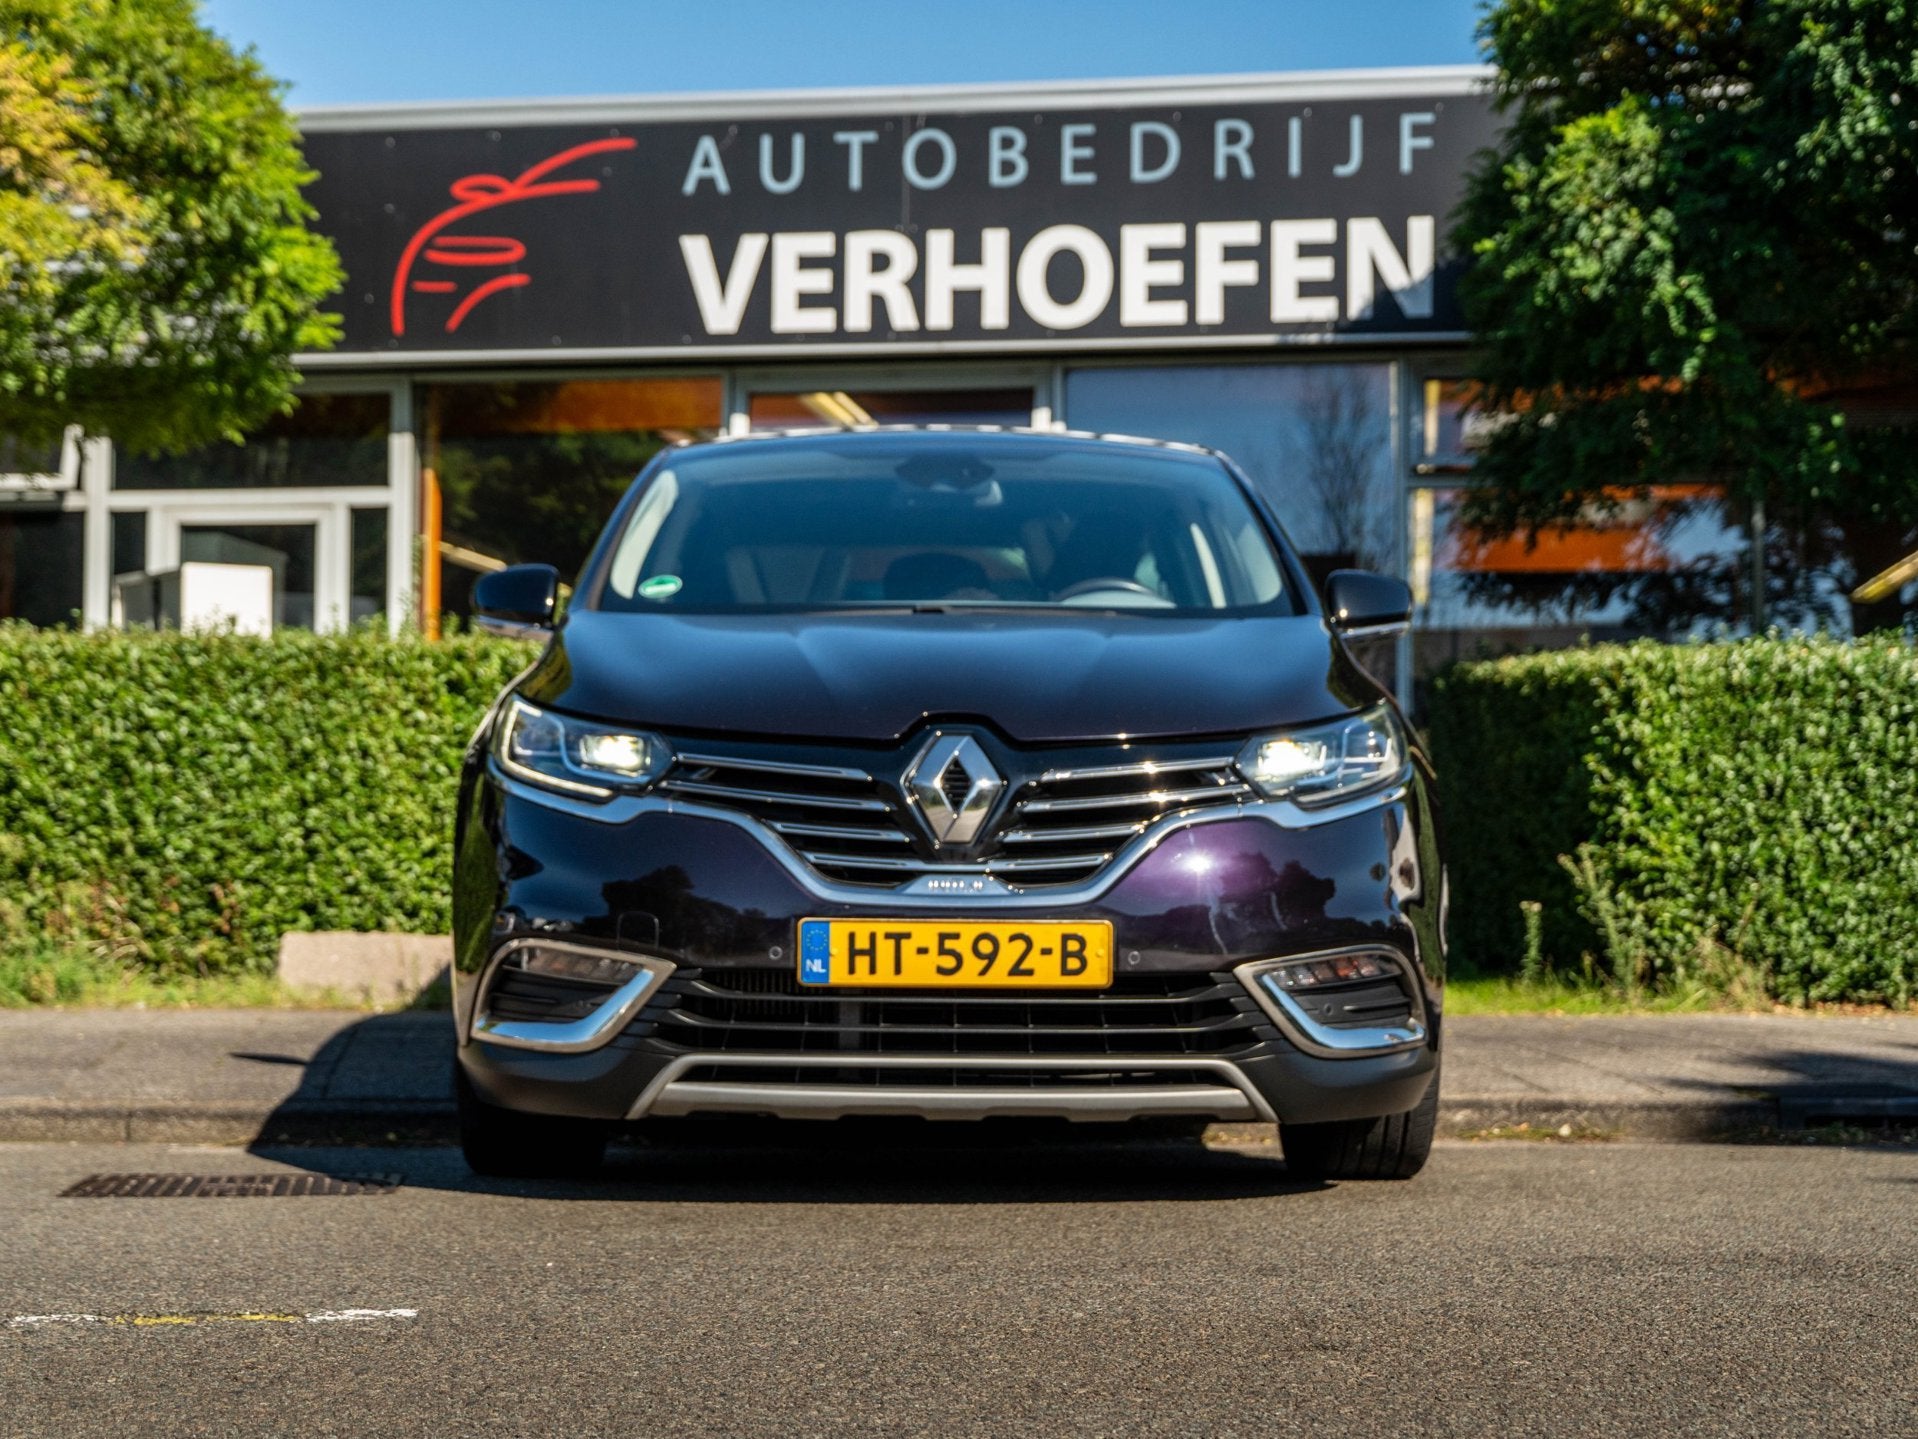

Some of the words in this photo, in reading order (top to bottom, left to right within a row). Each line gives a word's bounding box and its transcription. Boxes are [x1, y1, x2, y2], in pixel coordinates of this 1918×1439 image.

[682, 112, 1436, 196] AUTOBEDRIJF
[678, 215, 1436, 336] VERHOEFEN
[805, 958, 827, 974] NL
[847, 931, 1089, 978] HT-592-B
